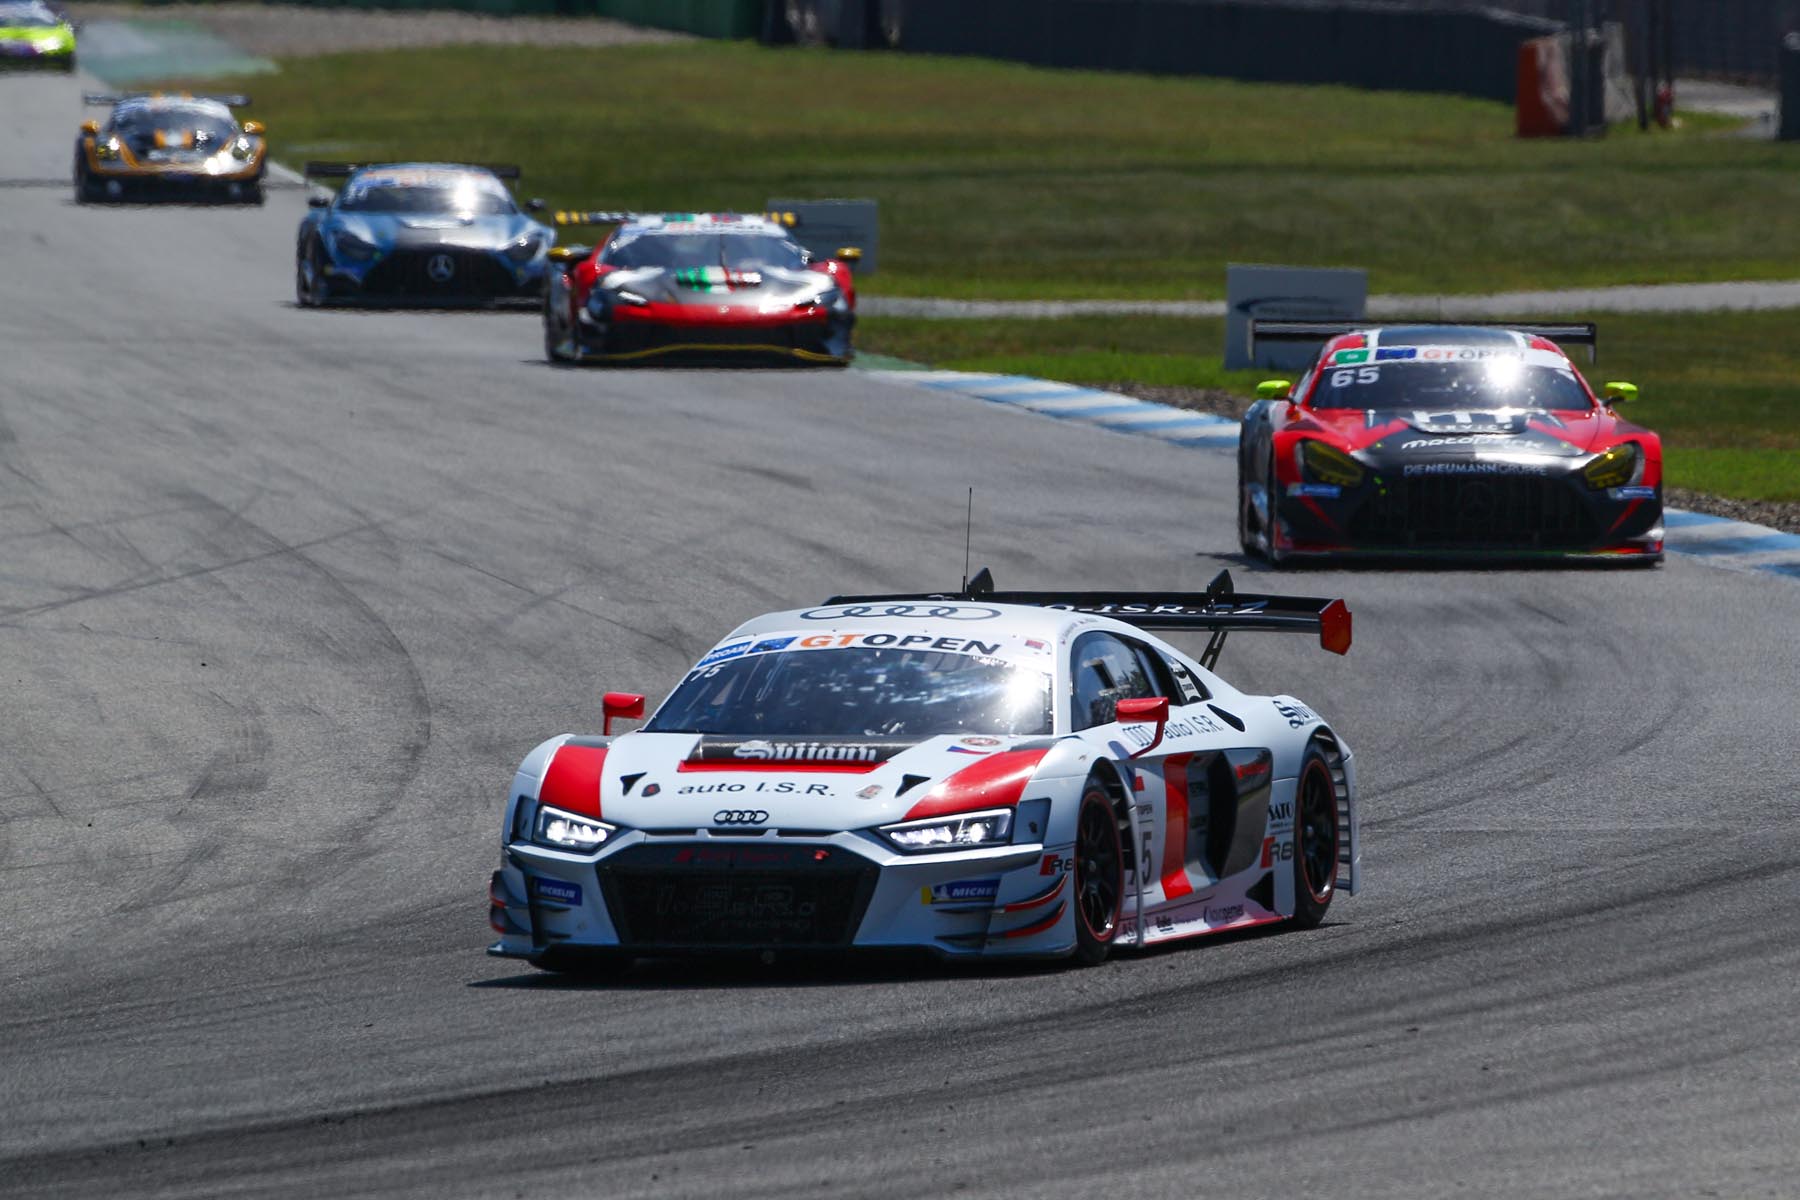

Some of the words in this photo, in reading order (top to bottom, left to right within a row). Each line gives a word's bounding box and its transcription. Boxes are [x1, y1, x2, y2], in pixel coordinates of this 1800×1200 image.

[1331, 367, 1380, 388] 65
[690, 664, 726, 682] 75
[677, 782, 745, 795] auto
[755, 782, 836, 796] I.S.R.
[951, 885, 998, 897] MICHE
